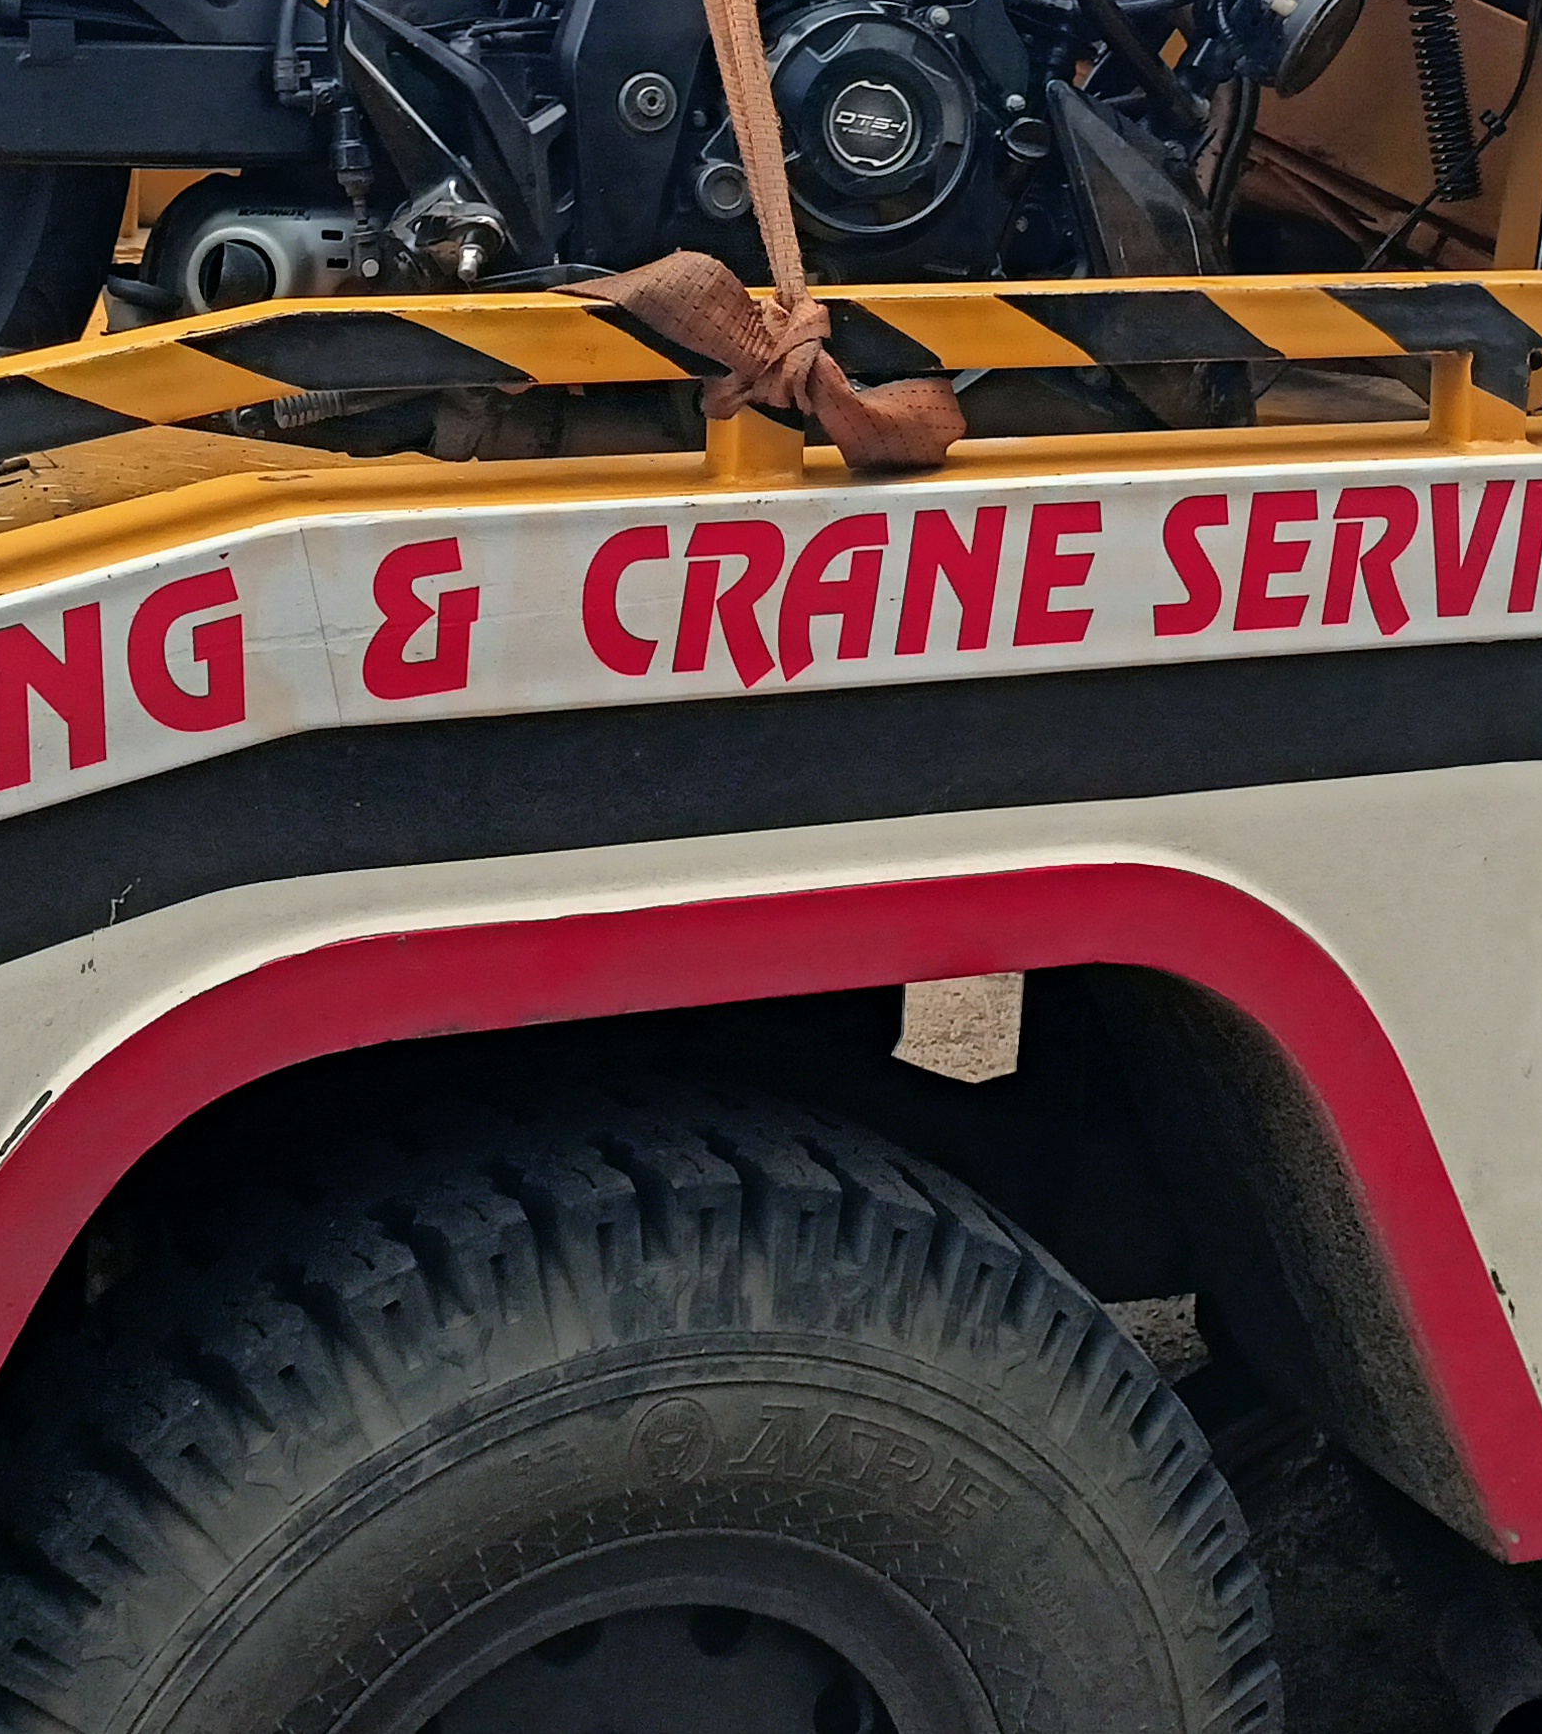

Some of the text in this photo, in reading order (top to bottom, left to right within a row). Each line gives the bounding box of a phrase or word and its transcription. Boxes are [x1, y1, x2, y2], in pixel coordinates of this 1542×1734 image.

[362, 536, 481, 701] &
[581, 501, 1103, 690] CRANE
[727, 1404, 1011, 1530] MRF
